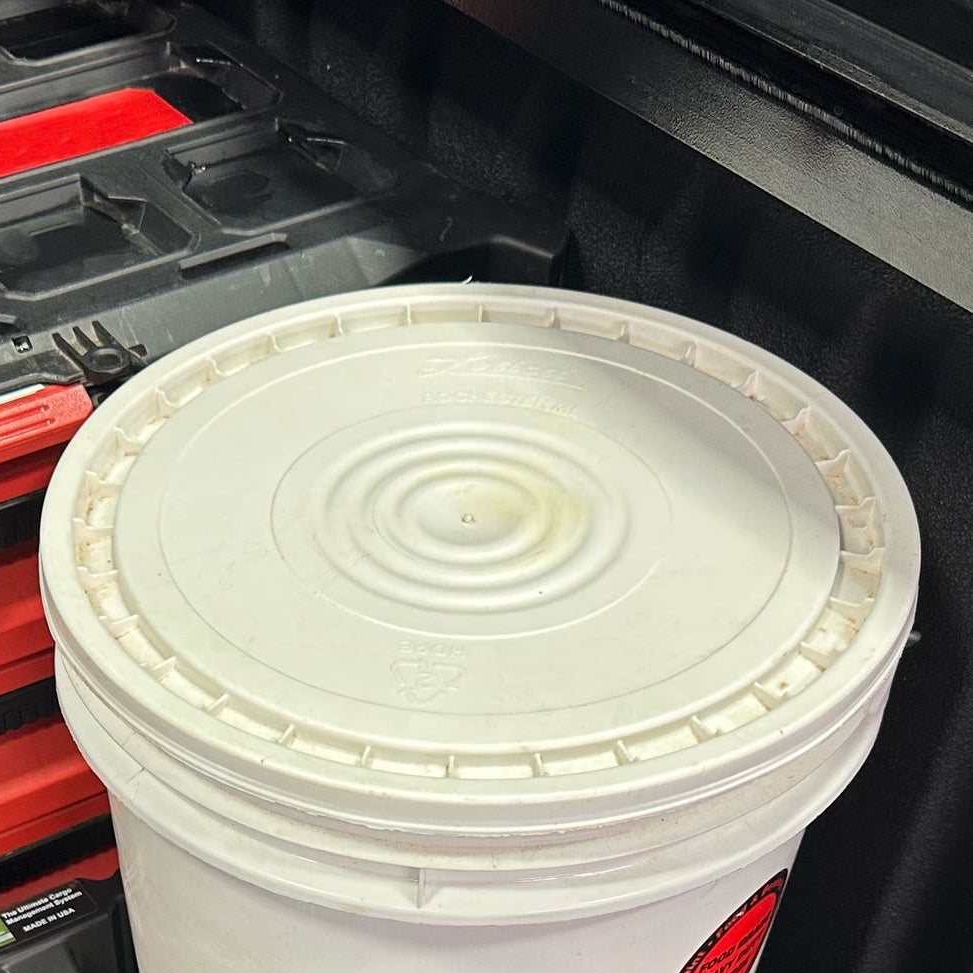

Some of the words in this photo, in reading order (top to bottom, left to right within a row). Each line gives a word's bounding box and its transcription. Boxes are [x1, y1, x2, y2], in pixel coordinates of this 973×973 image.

[1, 909, 17, 919] The
[17, 897, 49, 913] Ultimate
[49, 887, 72, 901] Cargo
[5, 902, 54, 926] Management
[54, 890, 83, 907] System
[22, 919, 48, 932] MADE
[48, 914, 57, 923] IN
[57, 907, 76, 919] USA
[716, 904, 747, 938] Food
